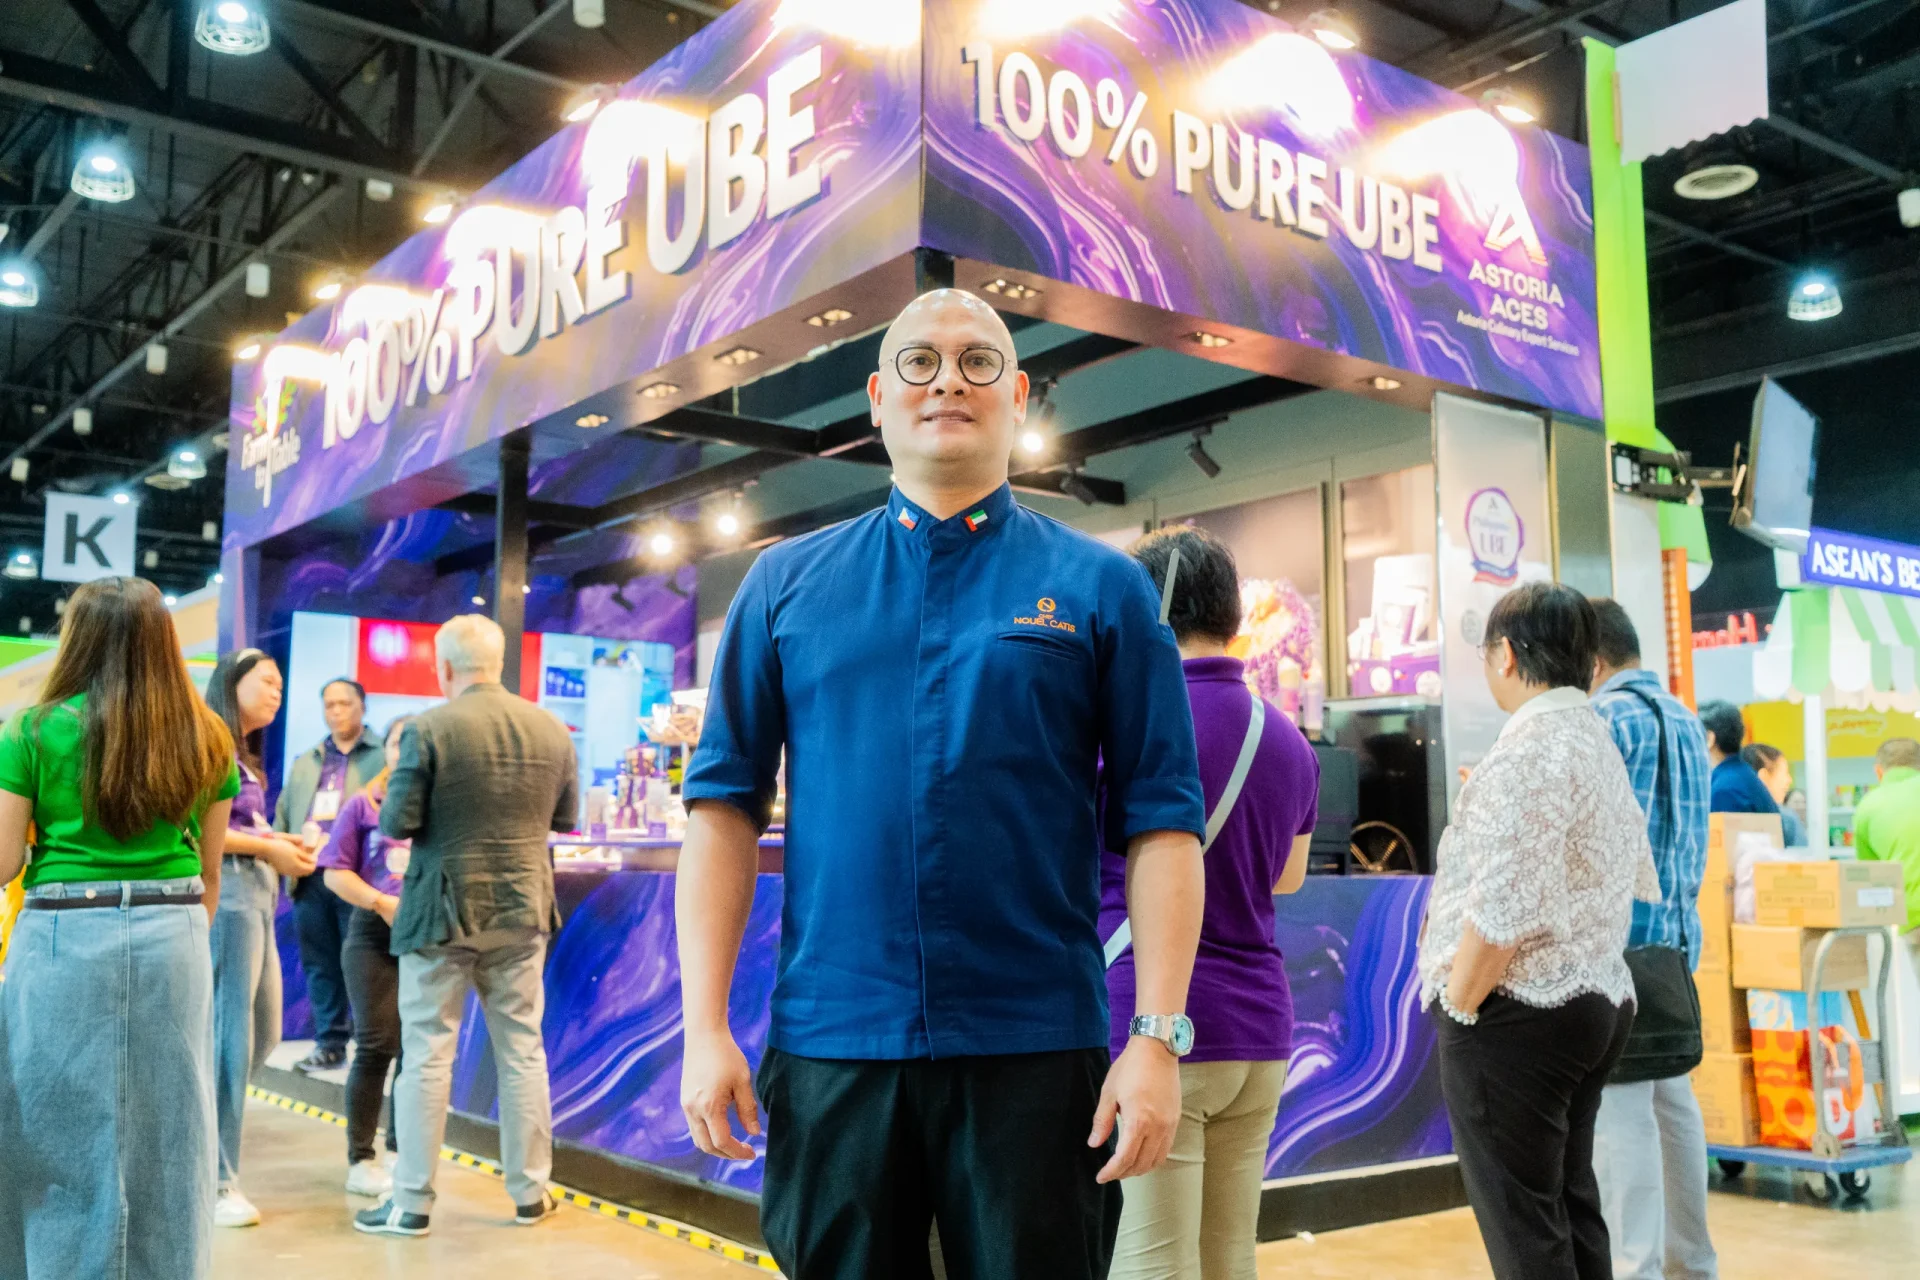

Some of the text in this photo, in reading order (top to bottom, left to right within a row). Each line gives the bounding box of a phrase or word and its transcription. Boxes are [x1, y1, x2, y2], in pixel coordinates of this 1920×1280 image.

[962, 40, 1444, 273] 100% PURE UBE
[318, 44, 827, 450] 100% PURE UBE
[1468, 258, 1565, 308] ASTORIA
[1489, 293, 1549, 330] ACES
[63, 513, 114, 568] K
[1812, 541, 1895, 586] ASEAN'S
[1049, 619, 1076, 633] CATIS
